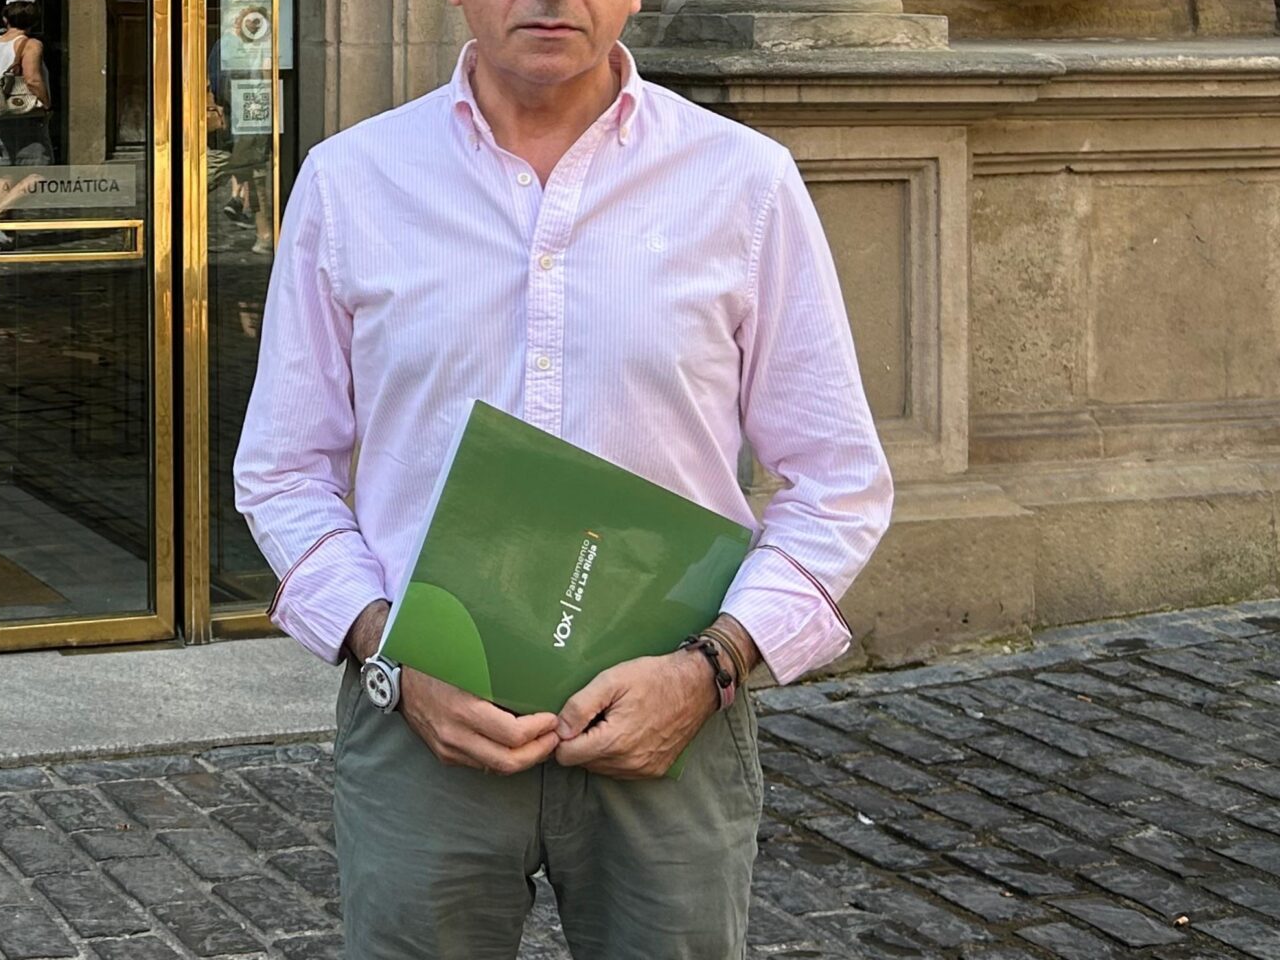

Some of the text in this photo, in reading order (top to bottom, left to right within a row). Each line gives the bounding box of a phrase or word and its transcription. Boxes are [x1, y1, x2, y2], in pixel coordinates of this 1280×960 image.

[19, 176, 120, 195] UTOMÁTICA
[566, 539, 590, 598] Parlamento
[574, 544, 598, 602] de La Rioja
[553, 611, 574, 647] VOX
